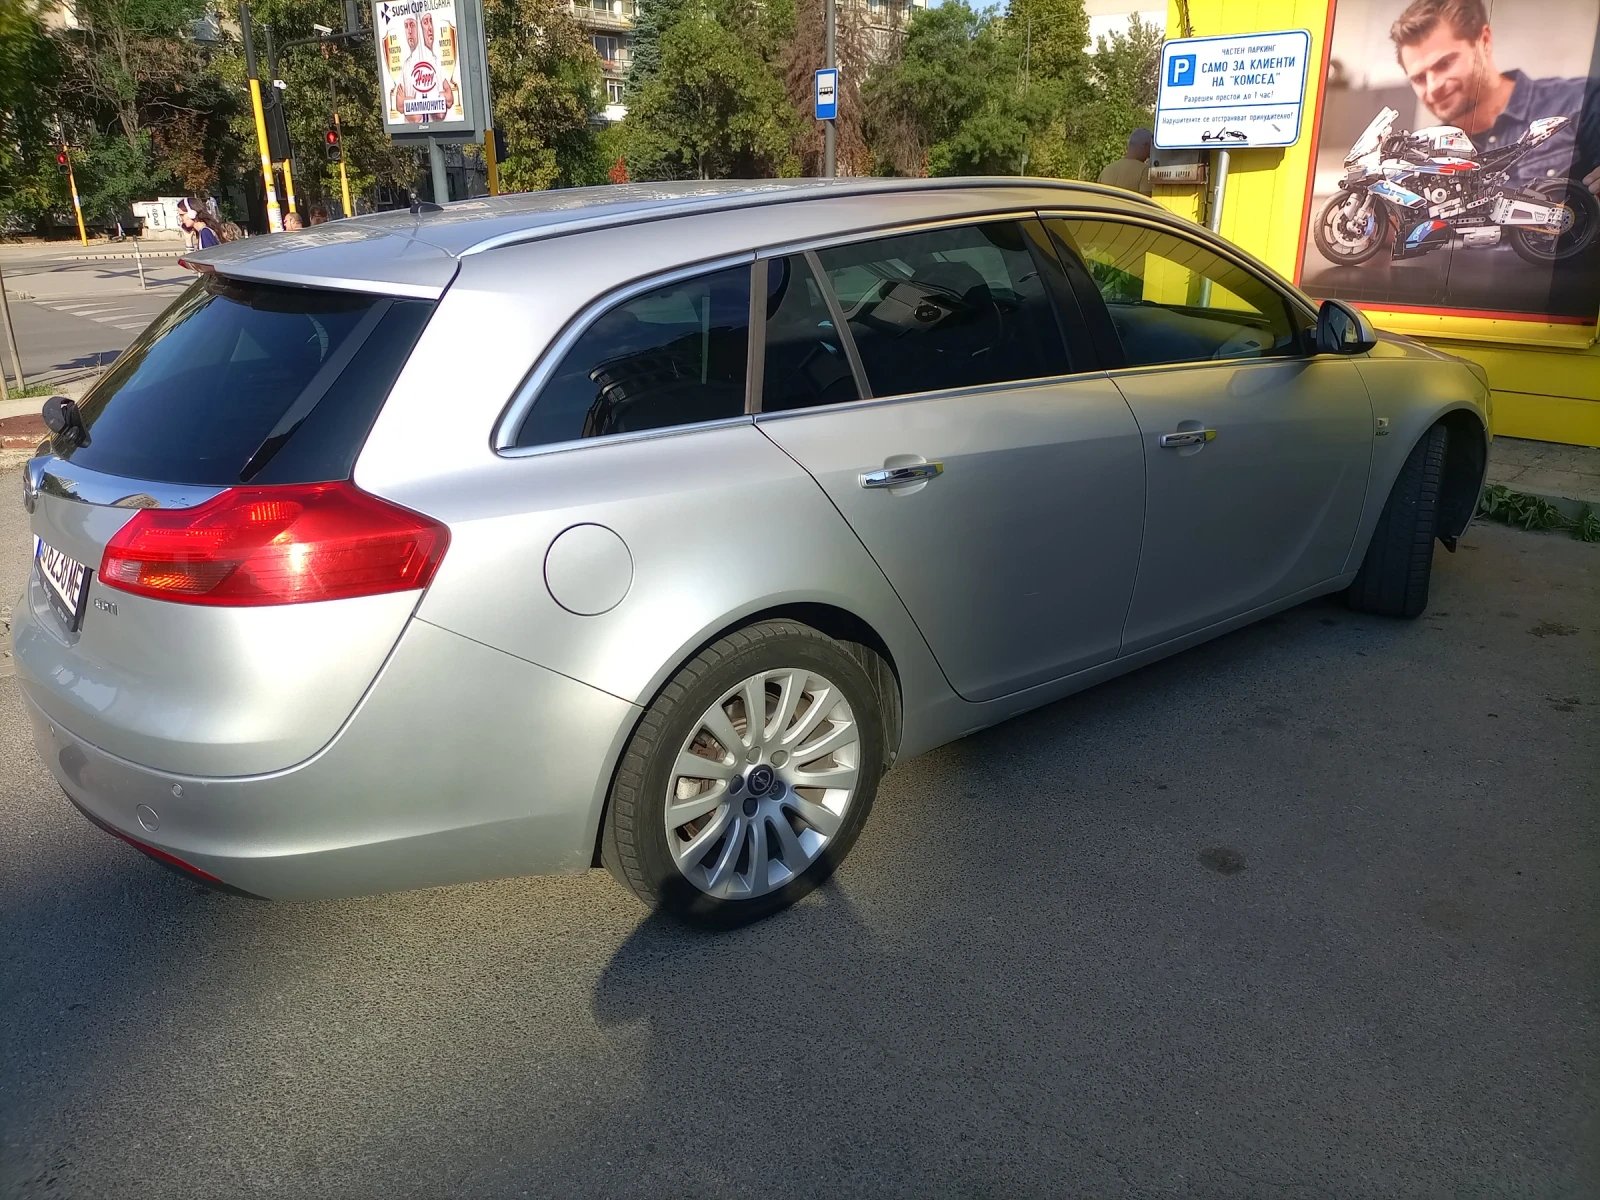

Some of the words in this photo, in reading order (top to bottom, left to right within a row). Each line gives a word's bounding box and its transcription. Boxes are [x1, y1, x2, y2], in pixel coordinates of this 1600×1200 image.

[392, 4, 410, 17] SUSHI
[411, 1, 423, 13] CUP
[424, 0, 451, 11] BULGARIA
[1222, 47, 1245, 56] ЧАСТЕН
[1248, 45, 1276, 54] ПАРКИНГ
[1174, 58, 1190, 83] P
[1201, 61, 1228, 73] САМО
[1233, 60, 1245, 71] ЗА
[1250, 56, 1296, 70] КЛИЕНТИ
[413, 70, 434, 87] Happy
[1212, 76, 1224, 87] НА
[1184, 95, 1214, 103] Разрешен
[1216, 93, 1241, 102] престой
[1261, 90, 1274, 99] час!
[405, 100, 445, 113] ШАМПИОНИТЕ
[1162, 116, 1201, 126] Нарушителите
[1212, 115, 1247, 124] отстраняват
[1249, 112, 1294, 122] принудително!
